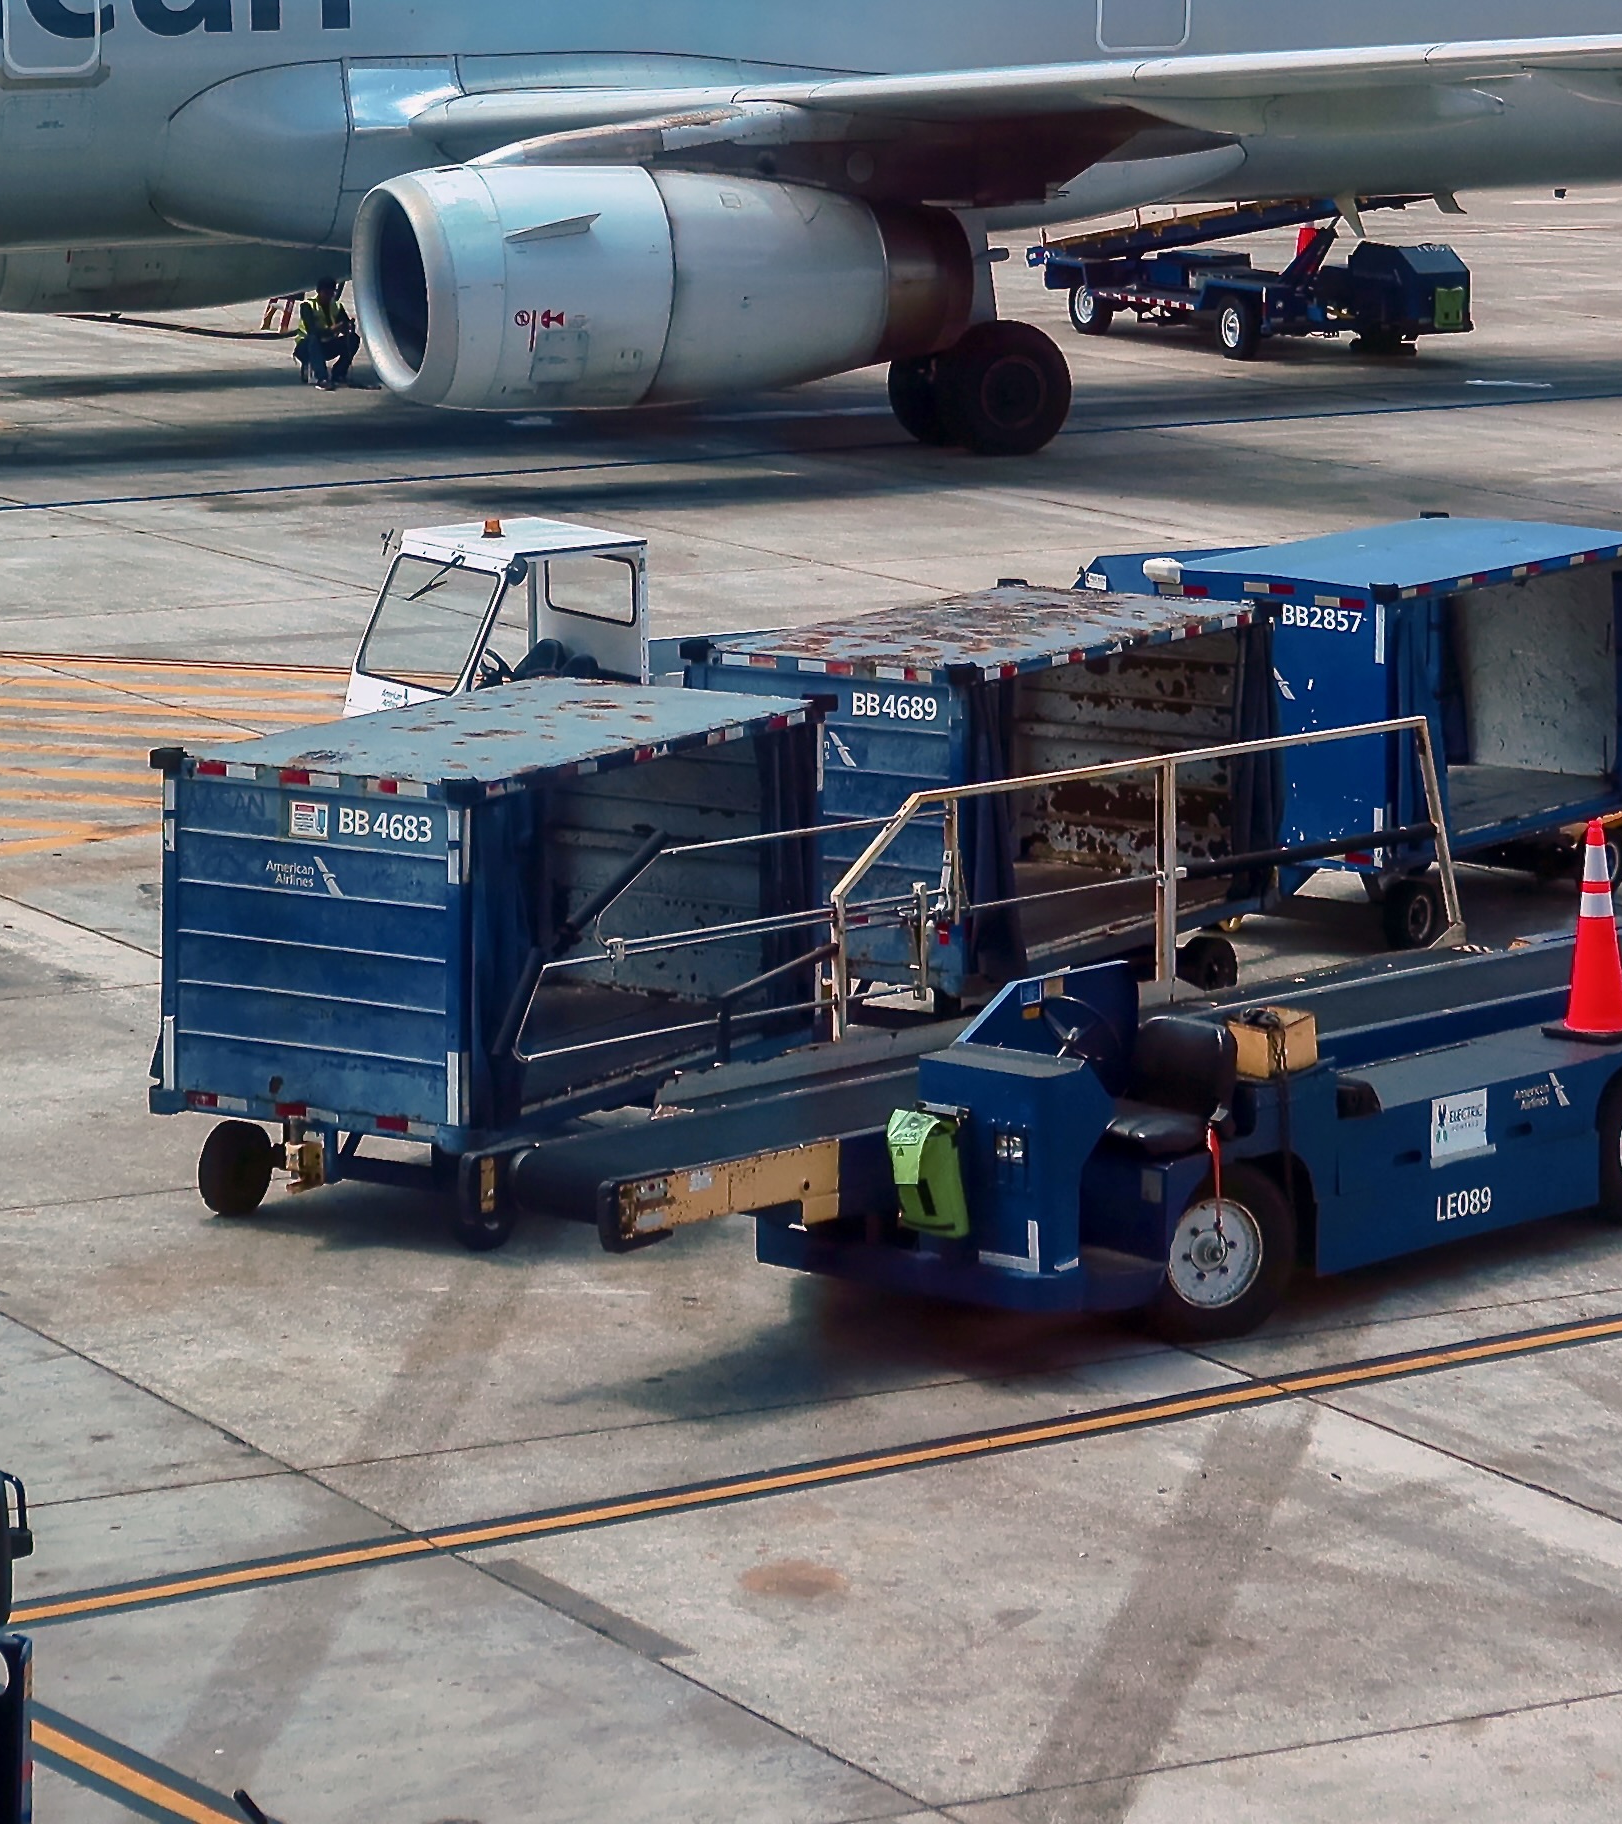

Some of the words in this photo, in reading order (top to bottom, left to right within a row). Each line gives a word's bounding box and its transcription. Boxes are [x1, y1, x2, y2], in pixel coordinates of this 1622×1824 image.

[1282, 604, 1363, 633] BB2857
[265, 860, 315, 876] American
[274, 873, 315, 889] Airlines
[1435, 1185, 1492, 1222] LE089
